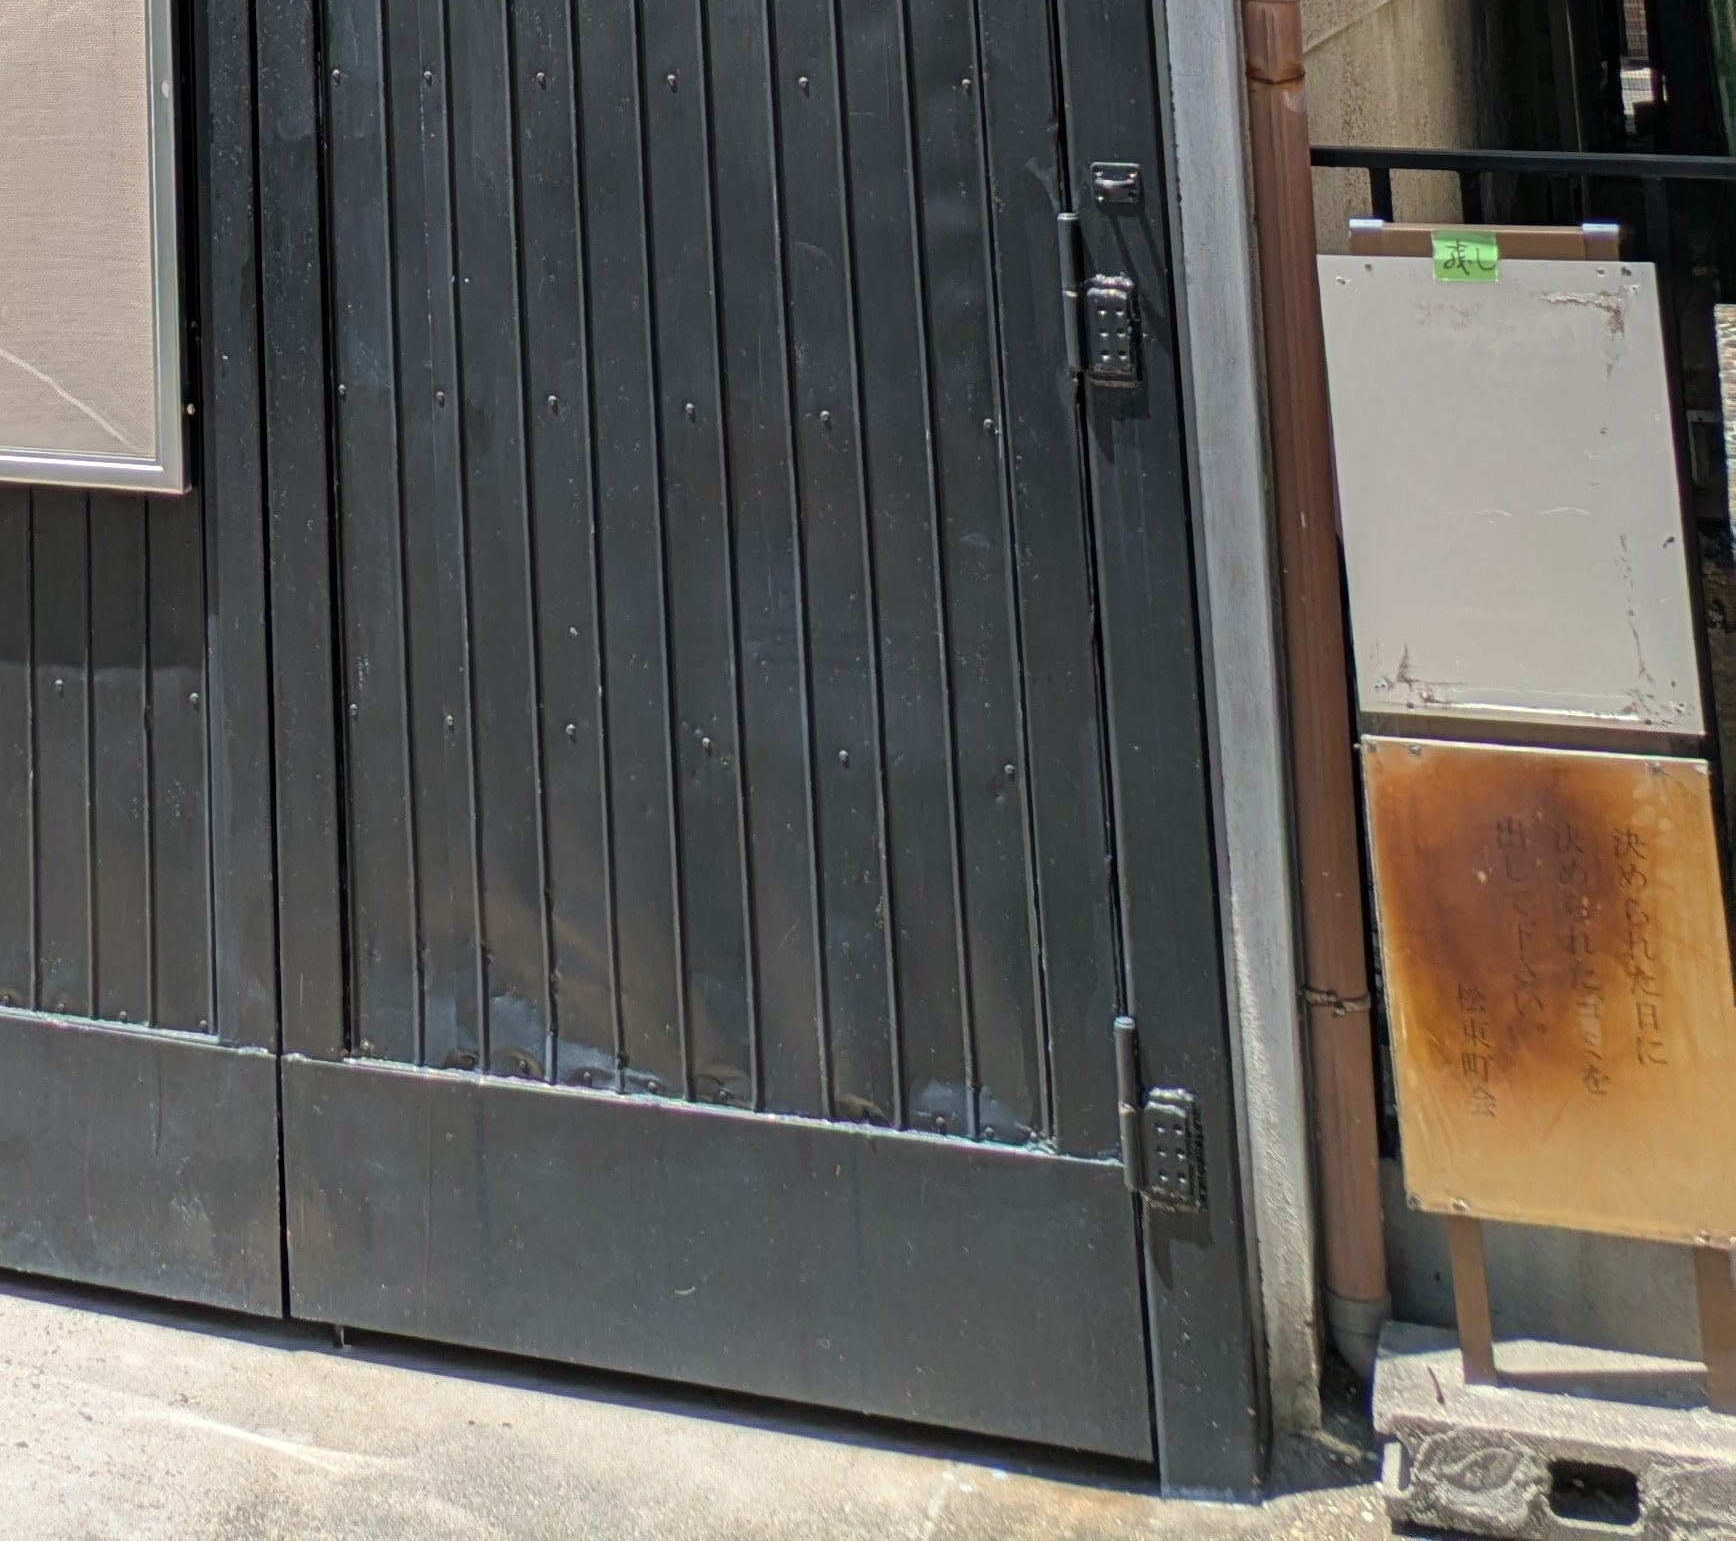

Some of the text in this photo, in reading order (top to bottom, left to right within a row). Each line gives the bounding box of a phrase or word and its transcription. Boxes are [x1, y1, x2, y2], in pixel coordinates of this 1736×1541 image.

[1614, 827, 1669, 1066] 決められた日に
